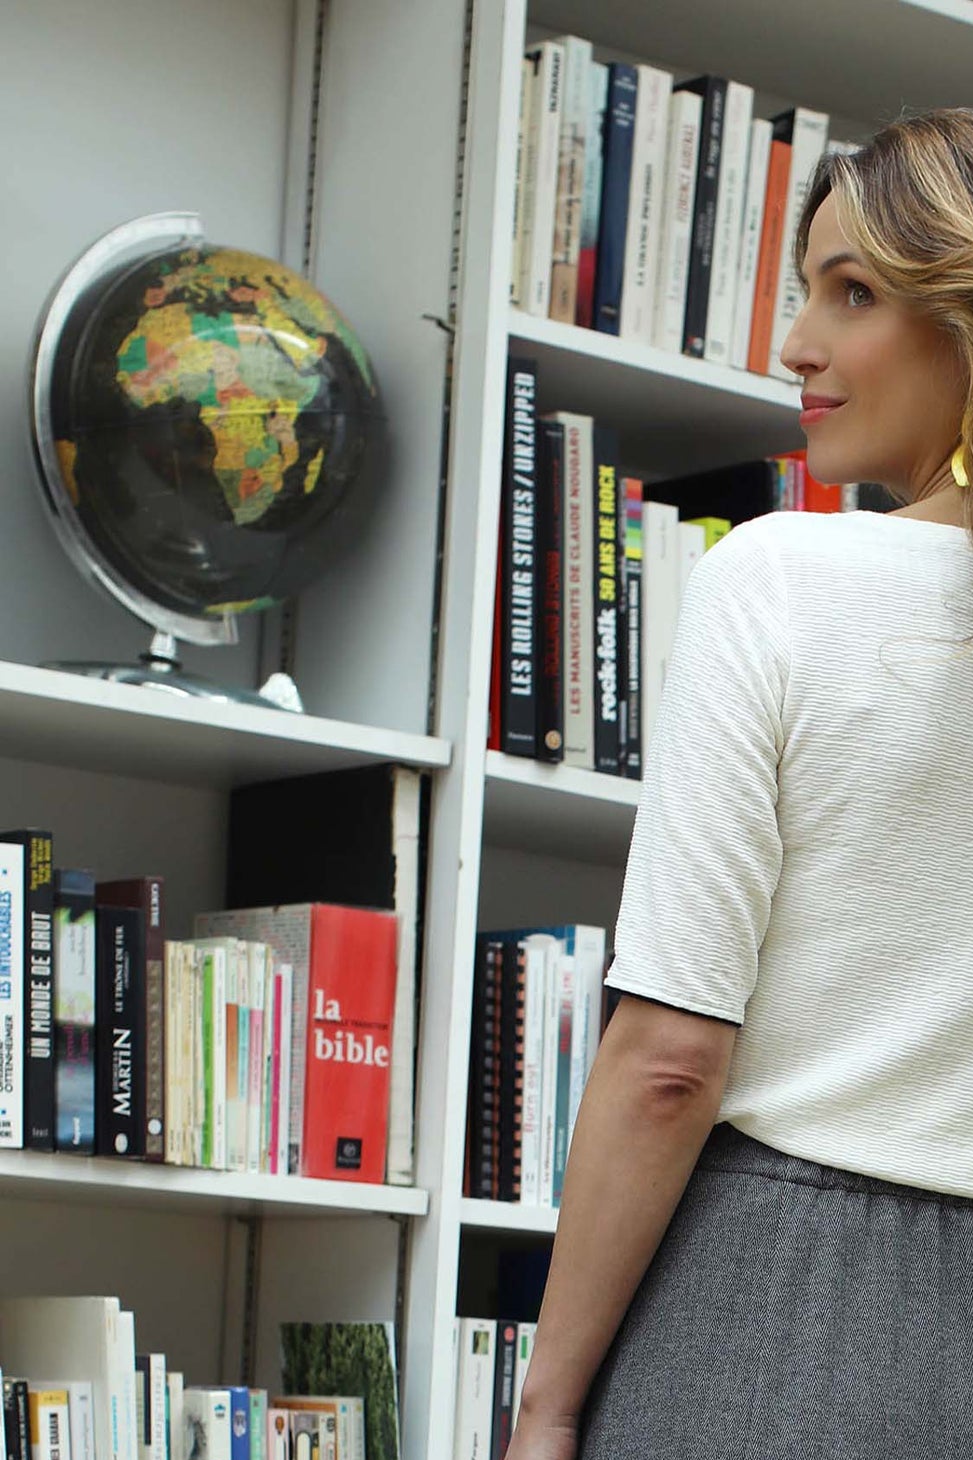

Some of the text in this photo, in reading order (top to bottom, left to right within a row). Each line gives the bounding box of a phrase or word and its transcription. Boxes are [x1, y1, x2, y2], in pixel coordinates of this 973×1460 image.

[514, 372, 535, 473] UNZIPPED
[513, 488, 534, 566] STONES
[600, 465, 615, 513] ROCK
[599, 542, 616, 577] ANS
[600, 518, 615, 540] DE
[569, 427, 581, 715] LES MANUSCRITS DE CLAUDE NOUGARO
[512, 574, 533, 663] ROLLING
[511, 669, 532, 696] LES
[1, 981, 11, 999] LES
[31, 911, 51, 1058] UN MONDE DE BRUT
[114, 925, 123, 1012] LE TRÔNE DE FER
[314, 989, 341, 1021] la
[5, 1015, 14, 1092] OTTENHEIMER
[112, 1028, 132, 1116] MARTIN
[314, 1028, 389, 1067] bible
